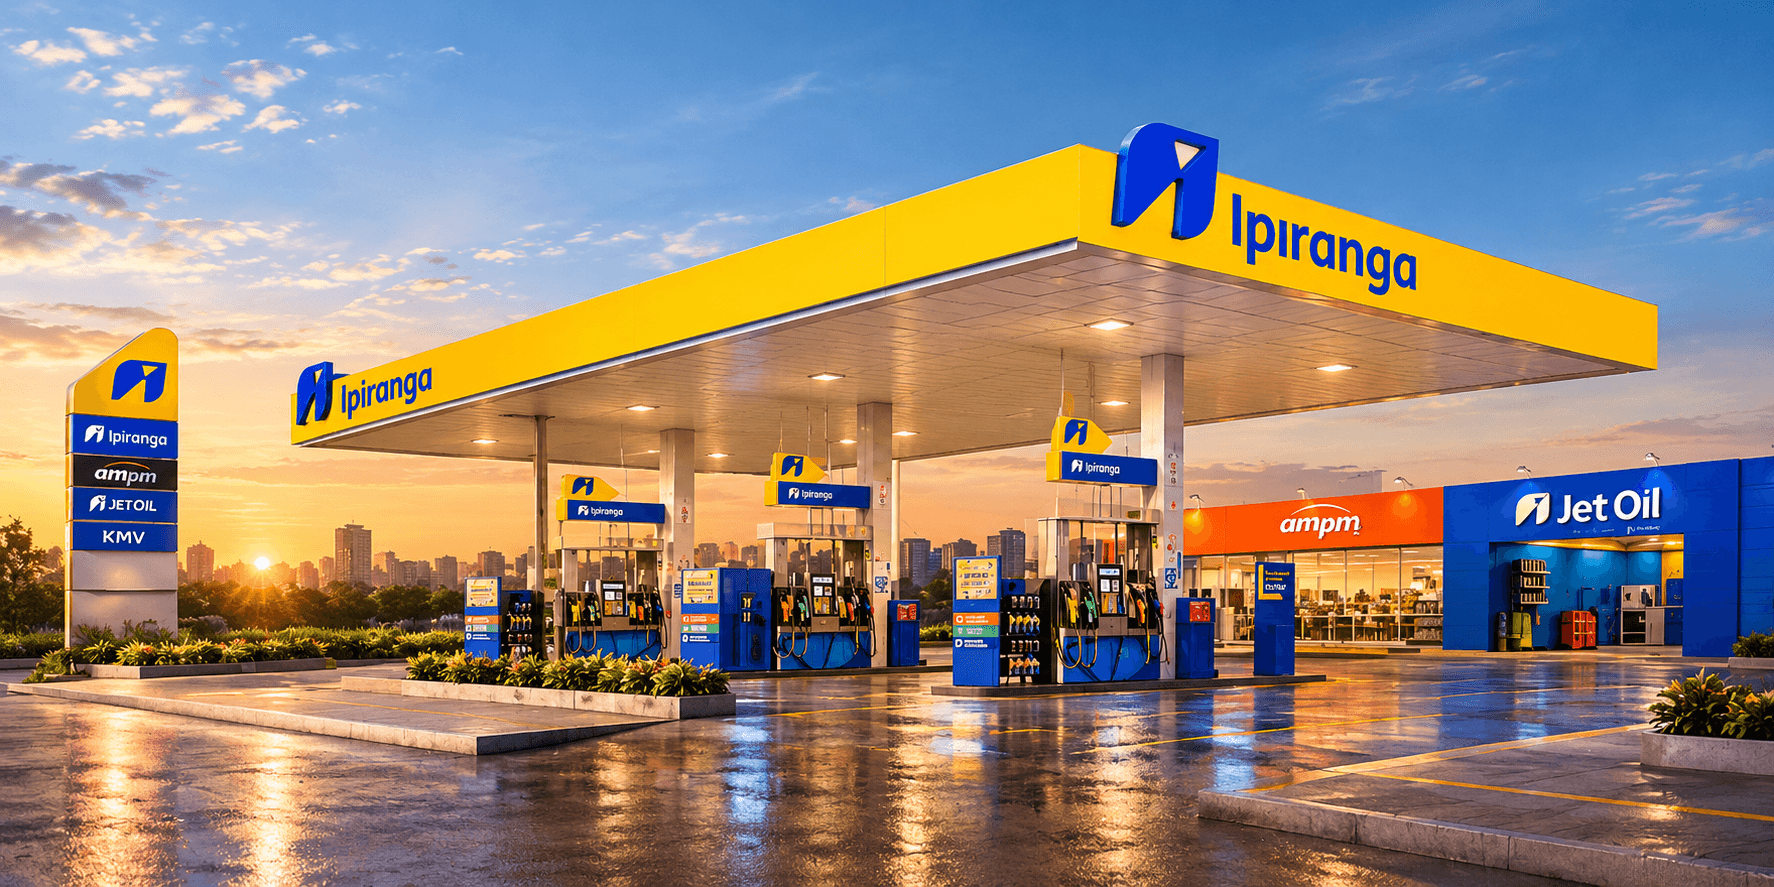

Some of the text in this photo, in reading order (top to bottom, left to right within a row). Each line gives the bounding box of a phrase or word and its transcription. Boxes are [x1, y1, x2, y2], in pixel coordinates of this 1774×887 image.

[1231, 193, 1418, 296] Ipiranga
[341, 367, 432, 420] Ipiranga
[108, 430, 168, 449] Ipiranga
[94, 465, 157, 487] ampm
[1085, 461, 1121, 476] Ipiranga
[801, 489, 833, 502] Ipiranga
[1556, 487, 1661, 524] Jet Oil
[102, 529, 146, 545] KMV
[1280, 513, 1361, 540] ampm
